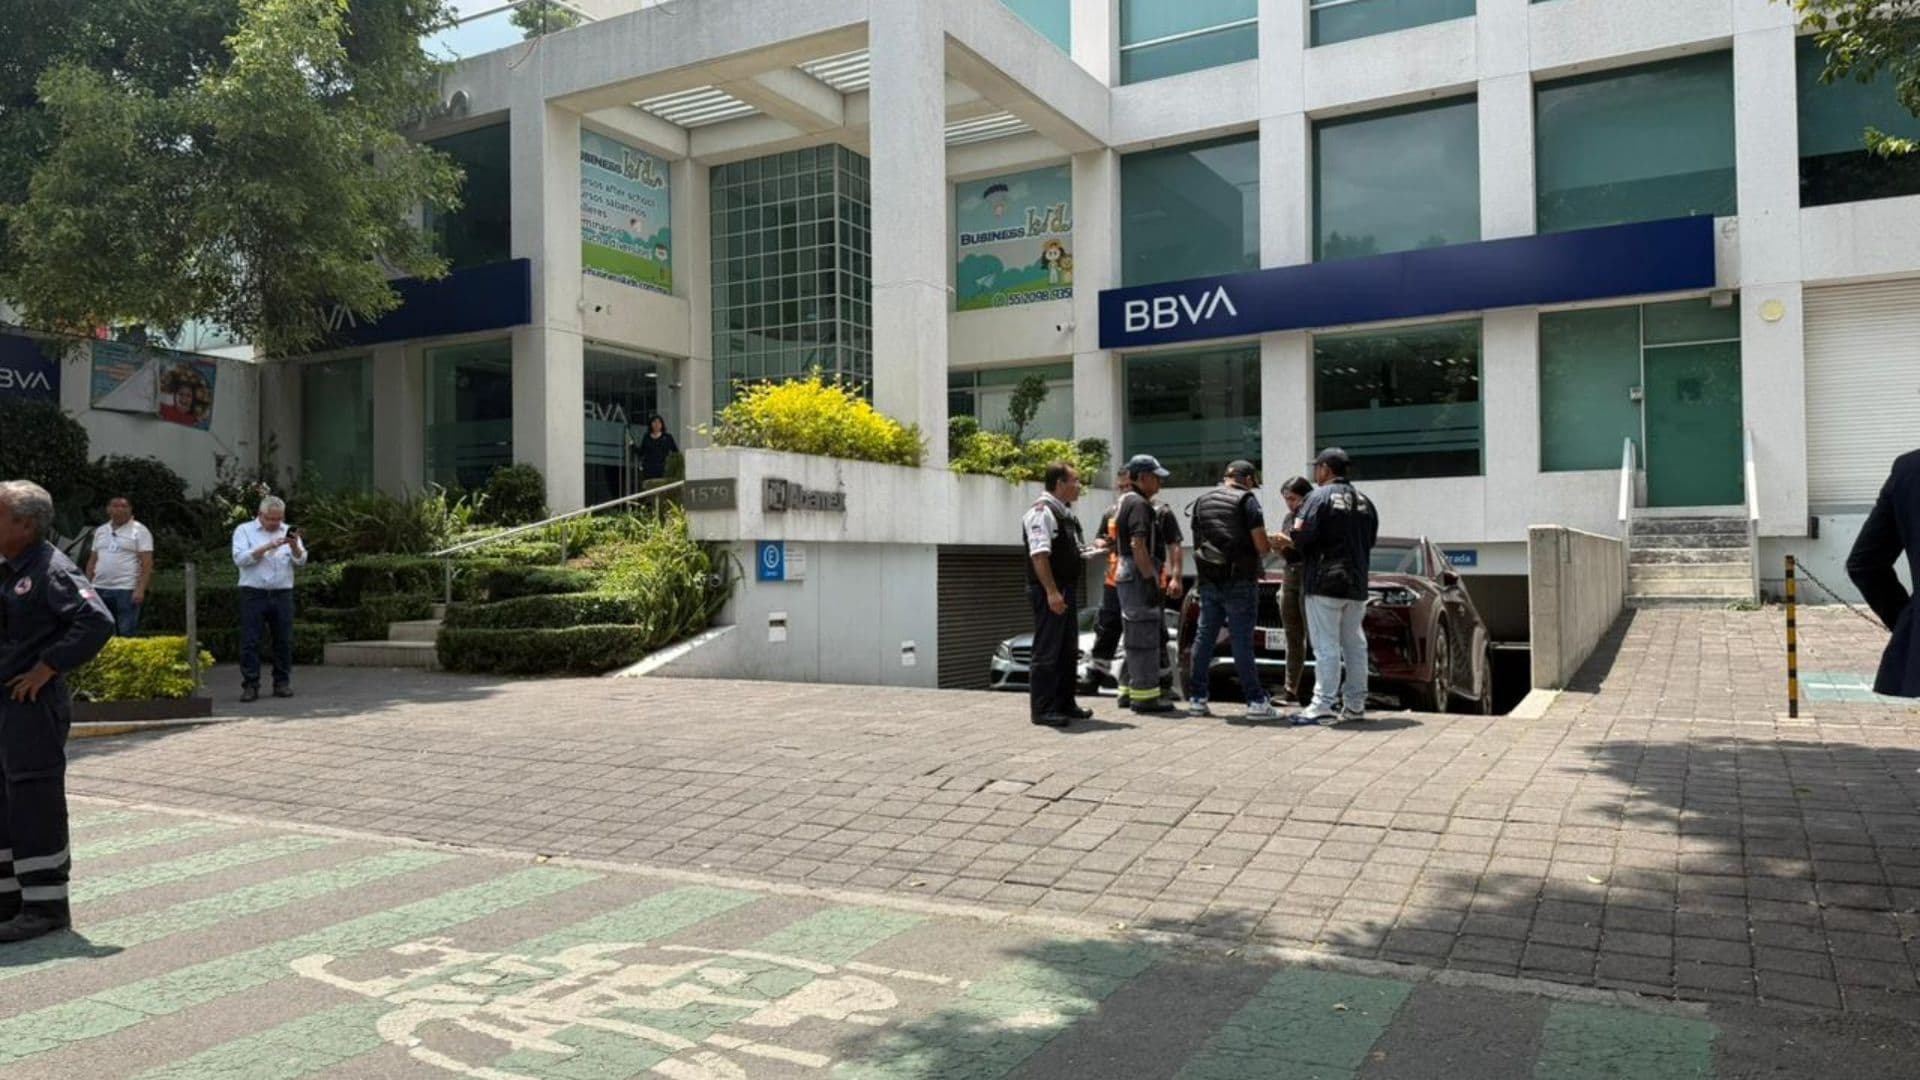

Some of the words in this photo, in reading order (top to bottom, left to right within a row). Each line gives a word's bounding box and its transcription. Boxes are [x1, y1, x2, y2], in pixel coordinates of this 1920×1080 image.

[960, 227, 1025, 246] BUSINESS
[1125, 285, 1238, 333] BBVA
[690, 486, 728, 502] 1579
